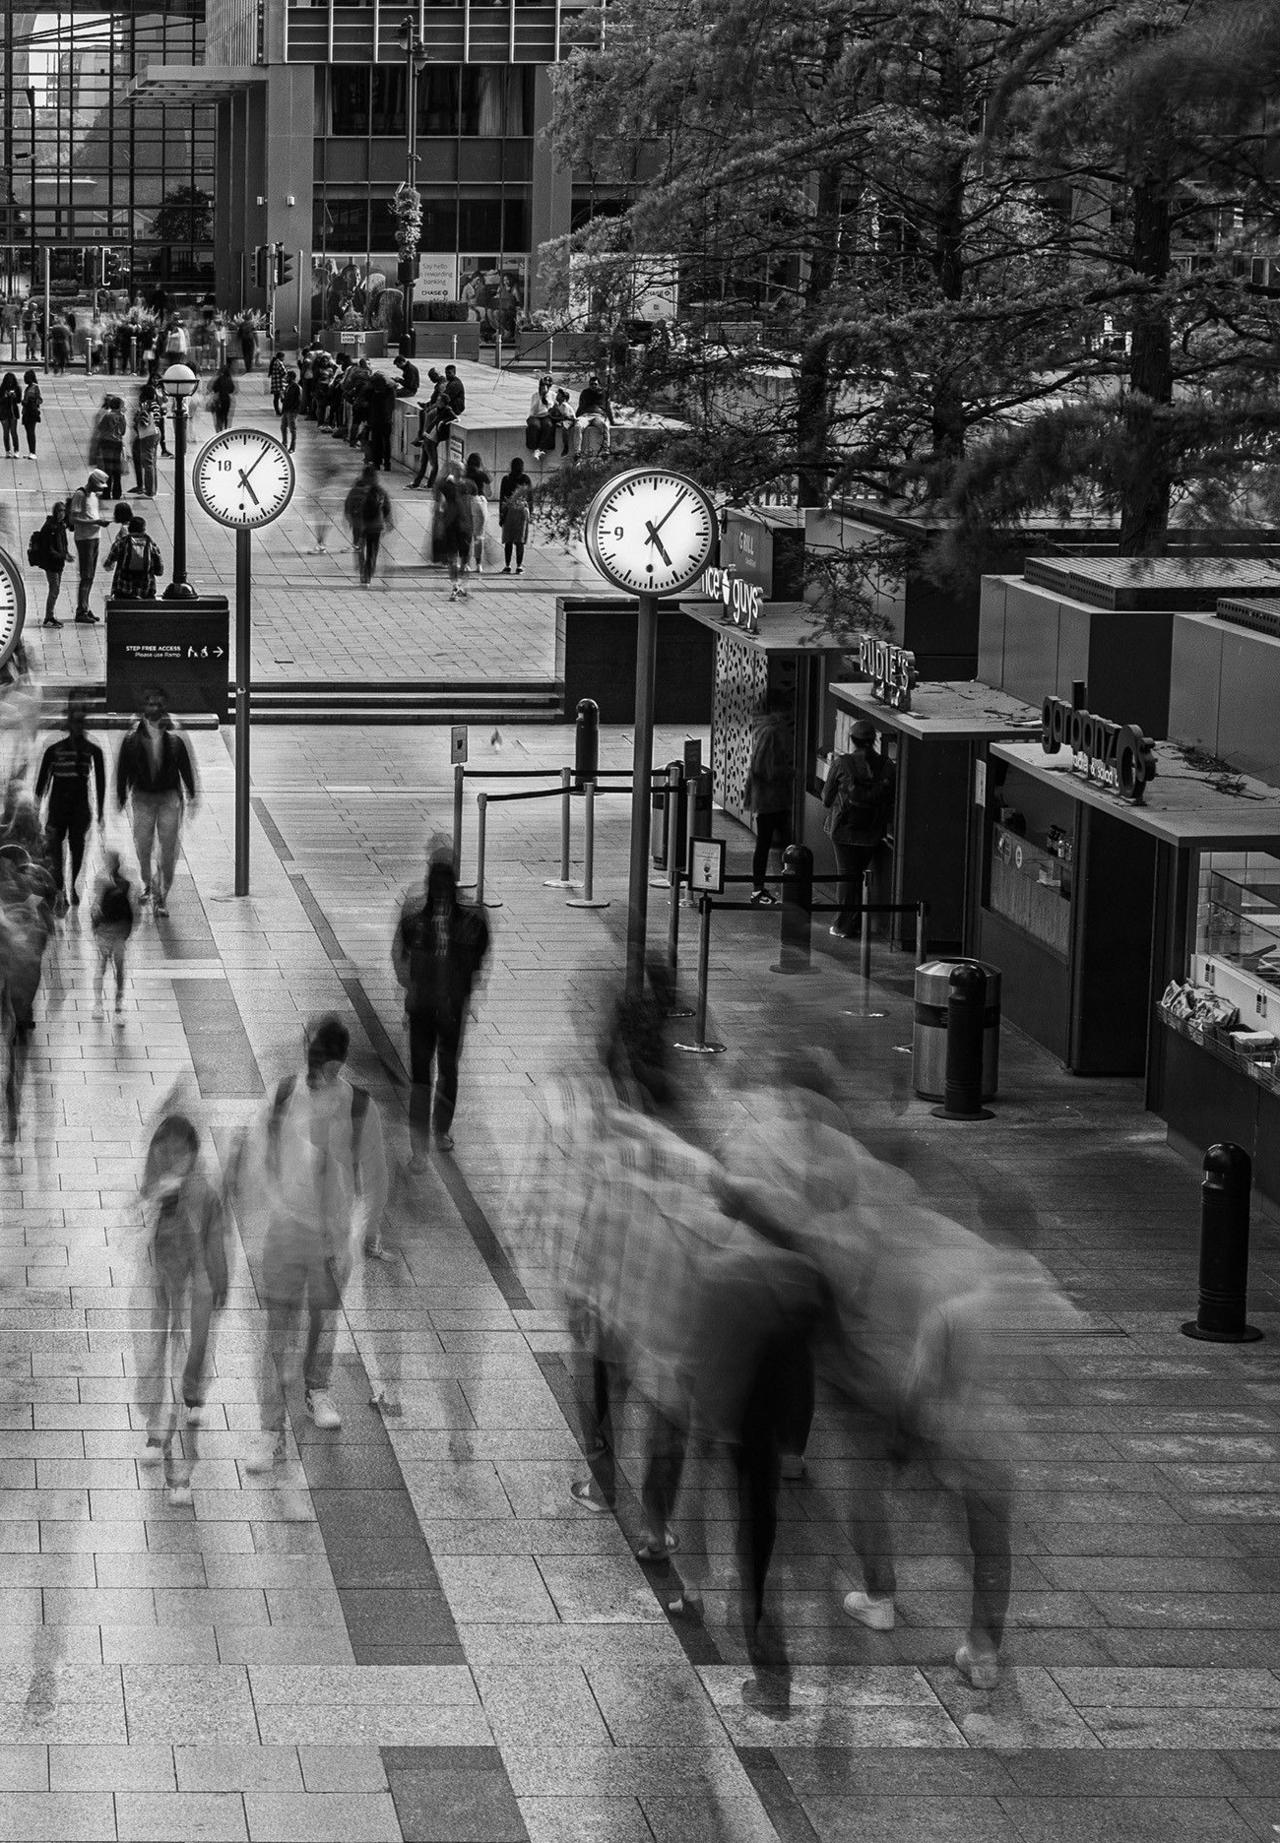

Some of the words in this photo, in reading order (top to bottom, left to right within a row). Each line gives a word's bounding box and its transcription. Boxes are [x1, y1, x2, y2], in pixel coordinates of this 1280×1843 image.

[217, 459, 232, 472] 10
[614, 526, 624, 541] 9
[732, 578, 759, 629] guys
